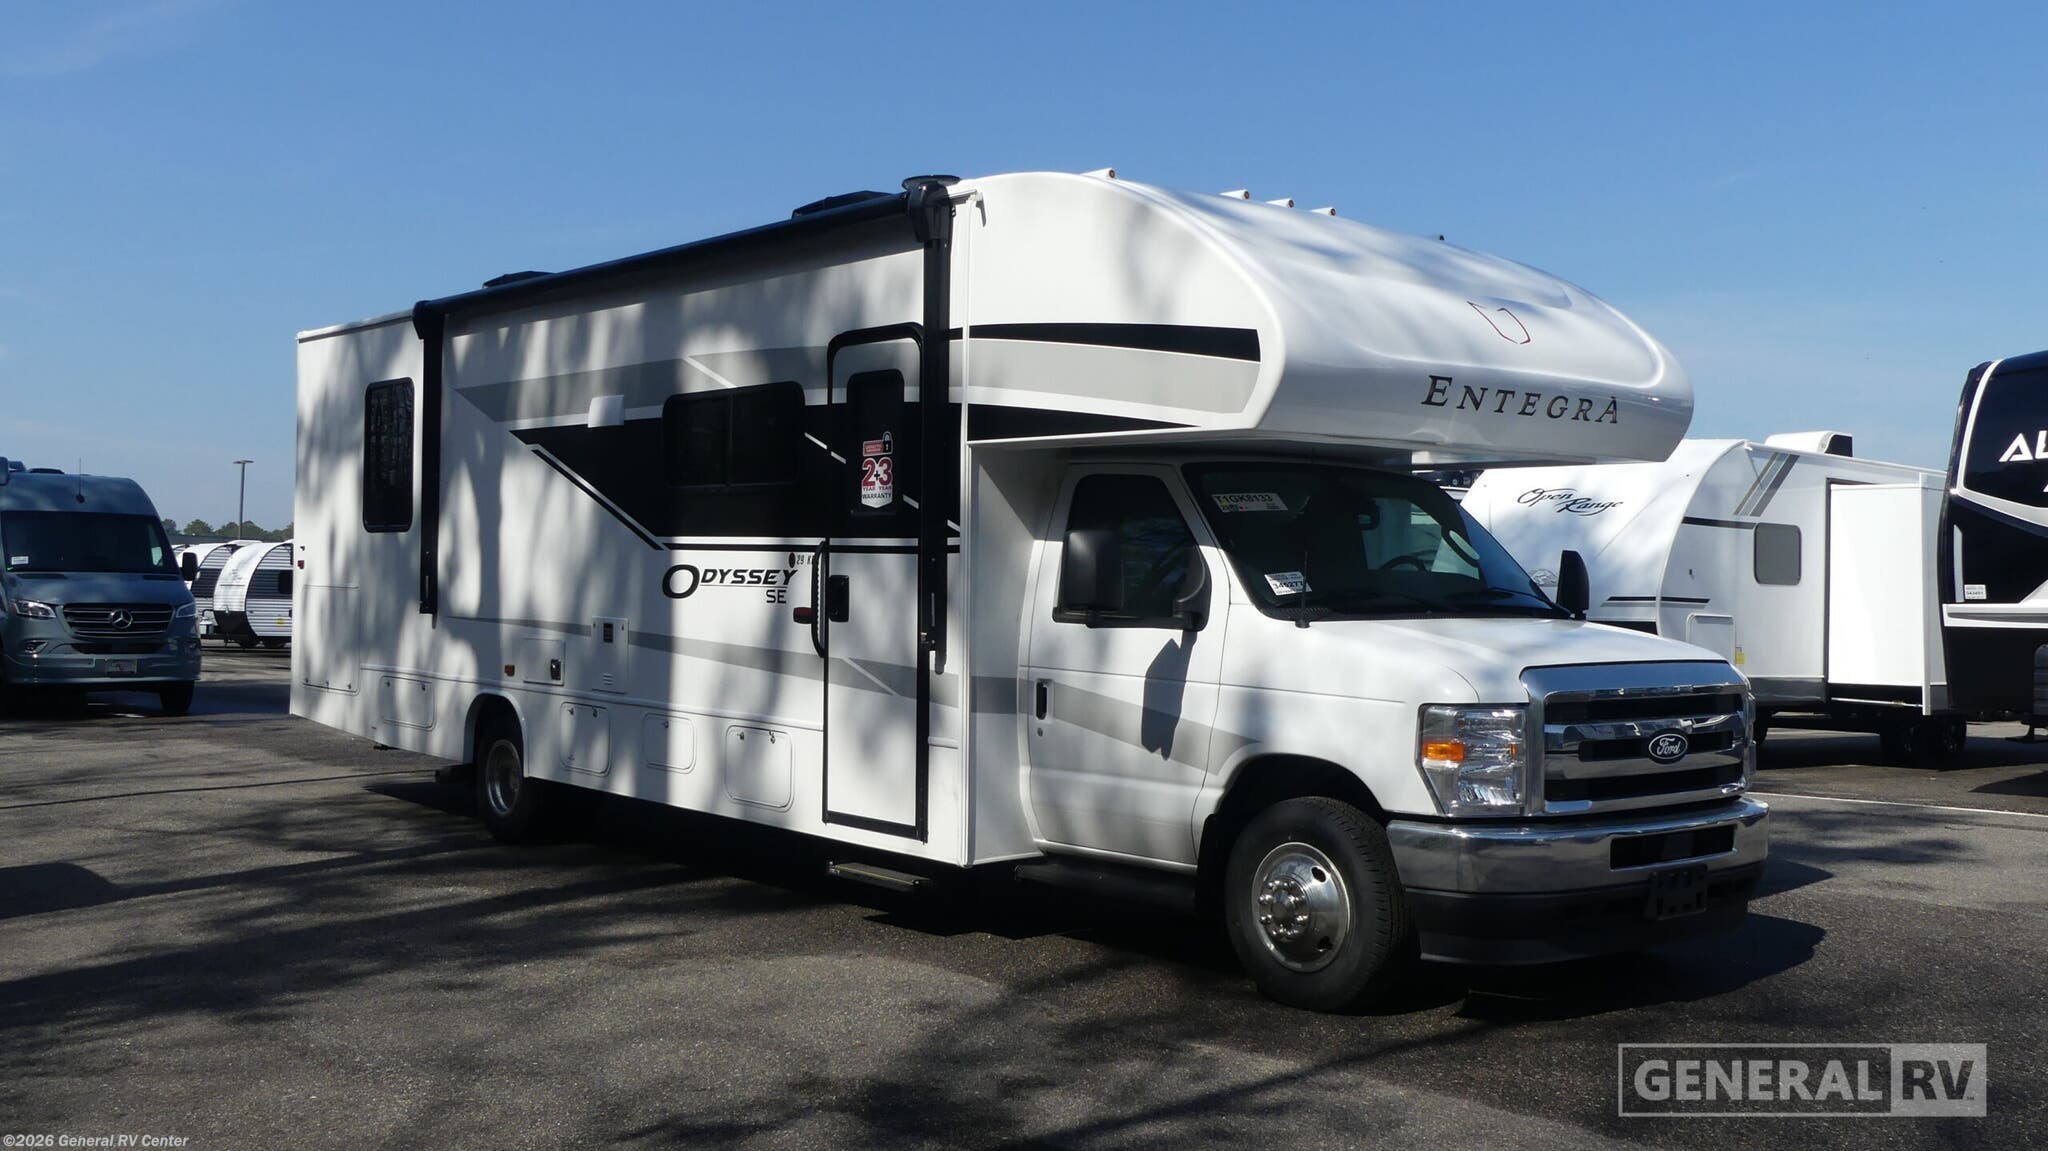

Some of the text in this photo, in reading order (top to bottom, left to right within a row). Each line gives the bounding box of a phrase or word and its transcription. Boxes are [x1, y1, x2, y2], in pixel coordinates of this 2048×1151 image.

[1421, 375, 1618, 424] ENTEGRA
[1517, 488, 1577, 507] Open
[1556, 497, 1624, 516] Range
[662, 564, 798, 599] ODYSSEY
[765, 590, 787, 604] SE
[1656, 737, 1681, 755] Ford
